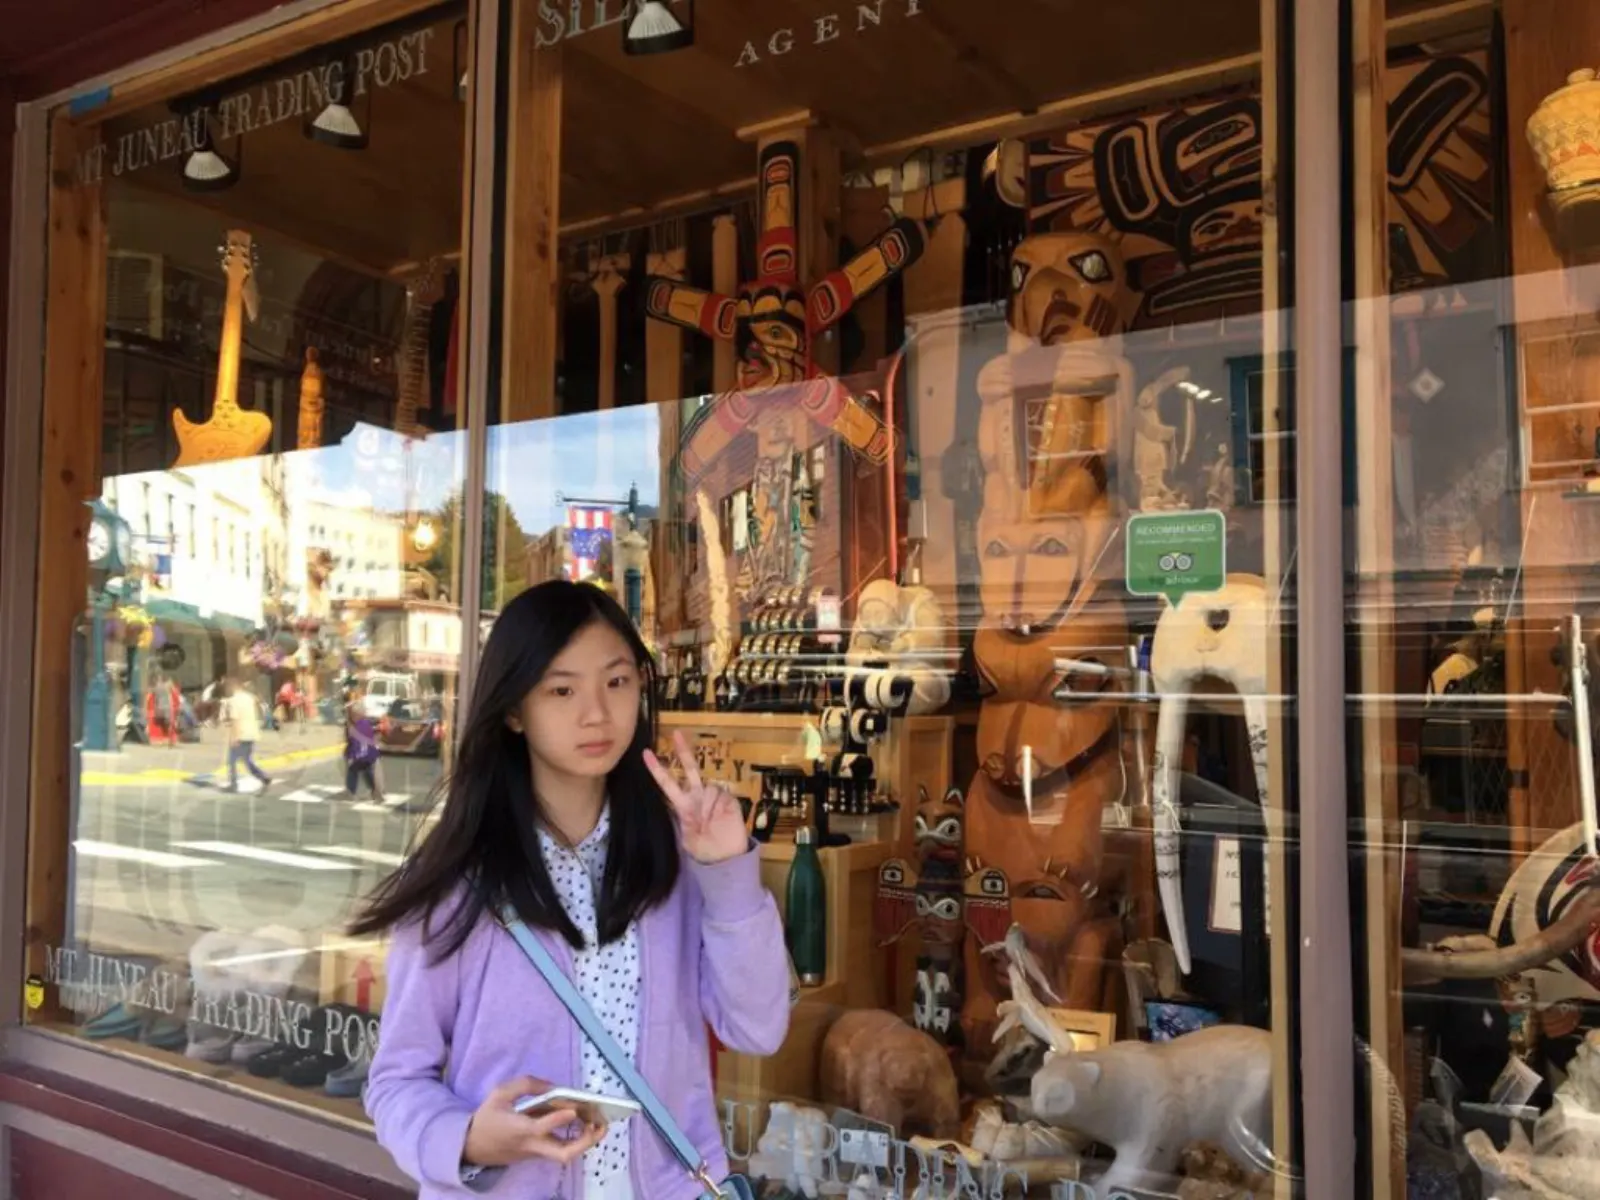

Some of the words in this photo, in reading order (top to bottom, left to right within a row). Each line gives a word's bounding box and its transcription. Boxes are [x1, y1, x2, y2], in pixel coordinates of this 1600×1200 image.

[113, 106, 210, 176] JUNEAU
[219, 61, 345, 140] TRADING
[354, 28, 434, 97] POST
[83, 953, 179, 1014] JUNEAU
[189, 976, 313, 1049] TRADING
[323, 1008, 380, 1063] POS
